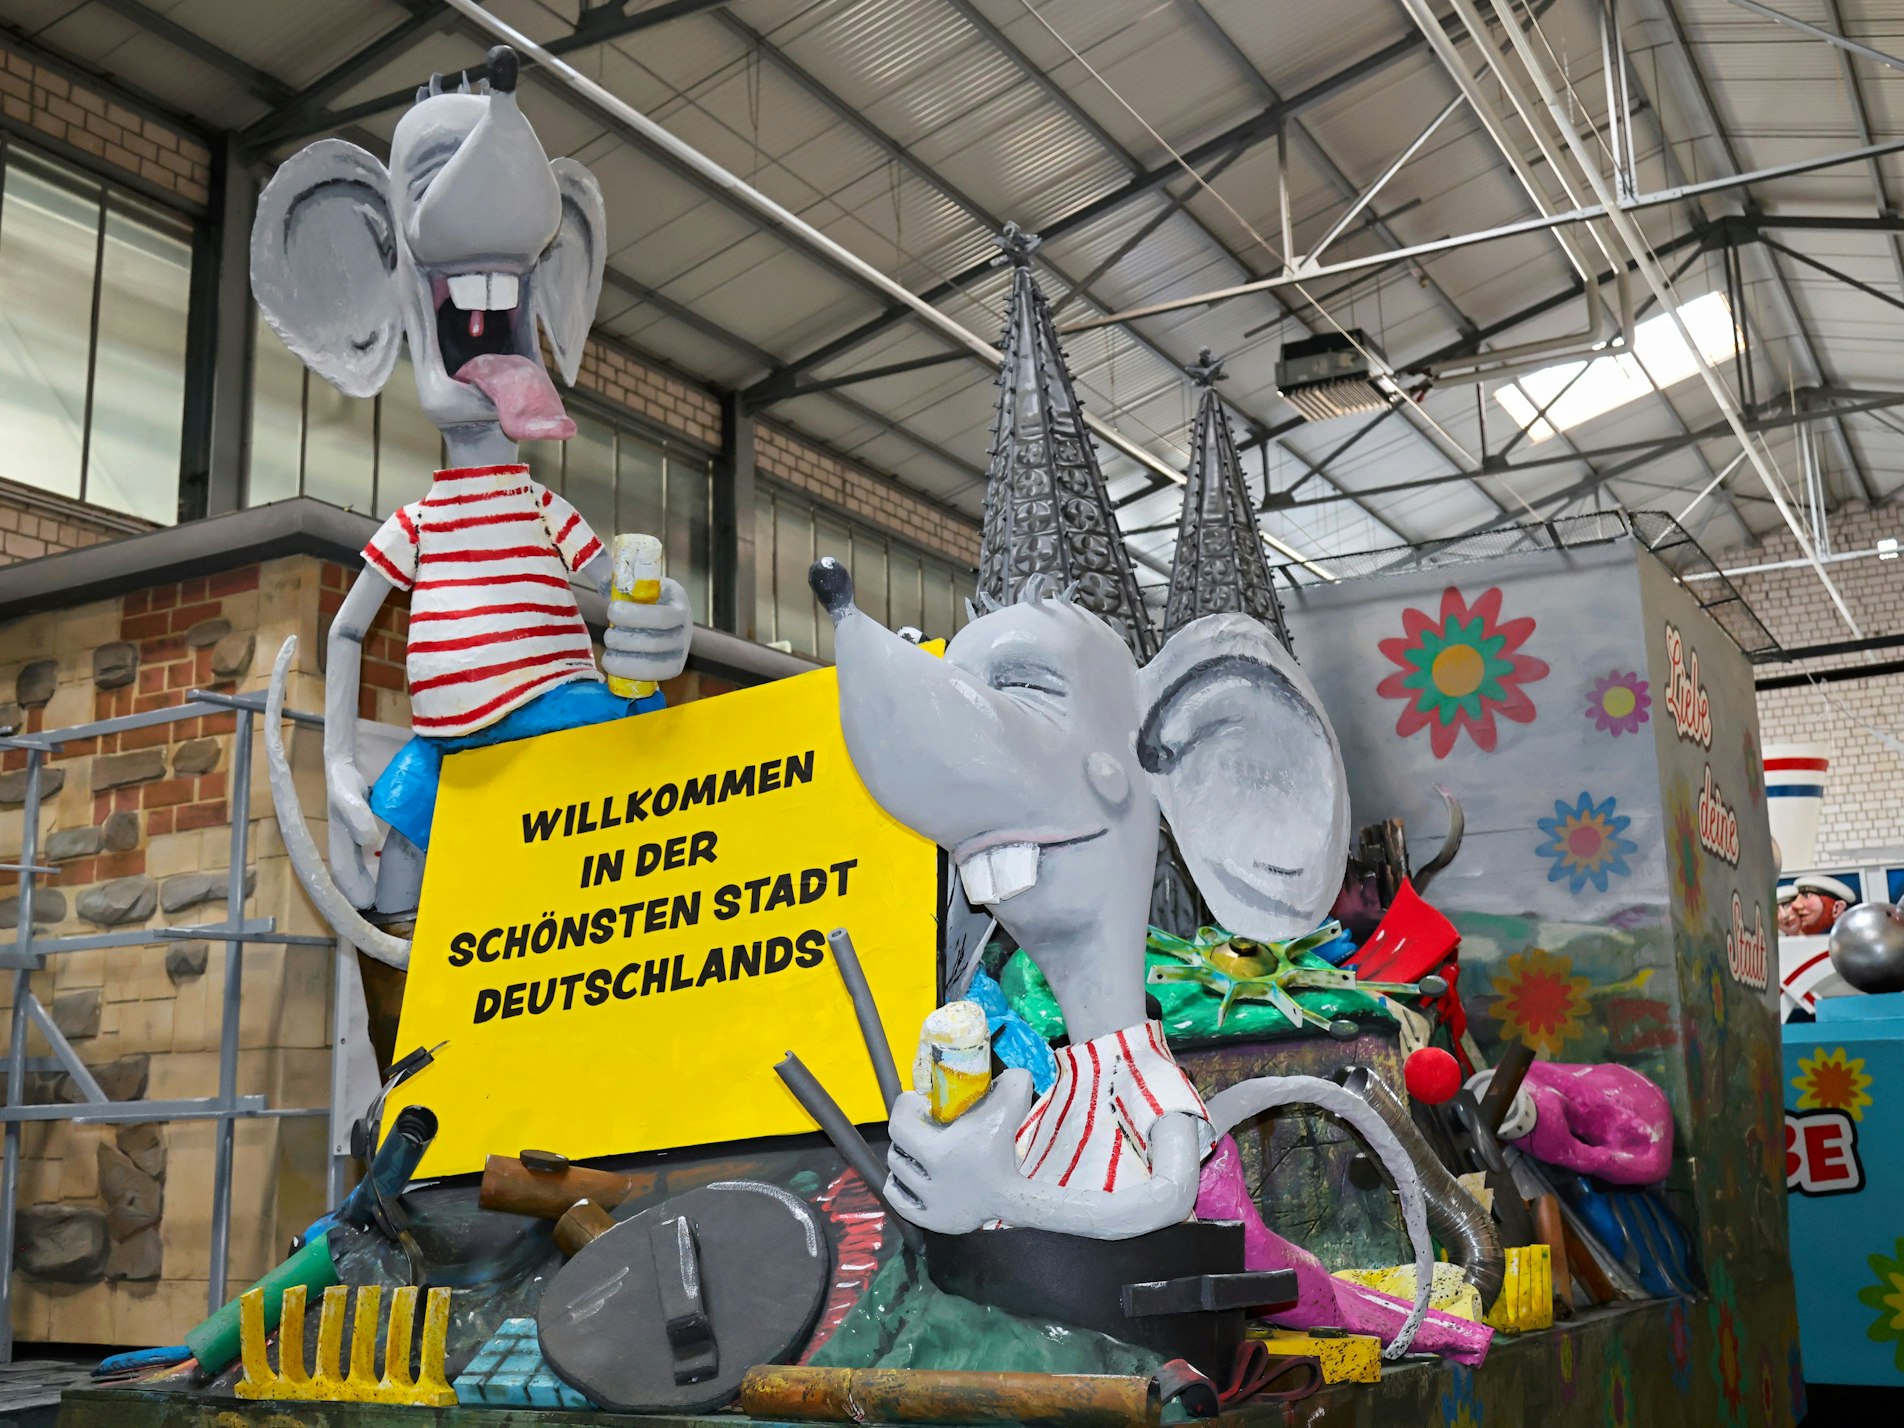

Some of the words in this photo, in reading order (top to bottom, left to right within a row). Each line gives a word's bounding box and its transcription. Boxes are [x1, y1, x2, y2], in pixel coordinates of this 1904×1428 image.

[1667, 629, 1710, 742] Liebe
[523, 751, 814, 843] WILLKOMMEN
[1700, 769, 1738, 860] deine
[581, 850, 624, 888] IN
[636, 831, 717, 876] DER
[449, 891, 700, 967] SCHÖNSTEN
[714, 859, 857, 920] STADT
[1728, 897, 1766, 985] Stadt
[474, 930, 825, 1023] DEUTSCHLANDS
